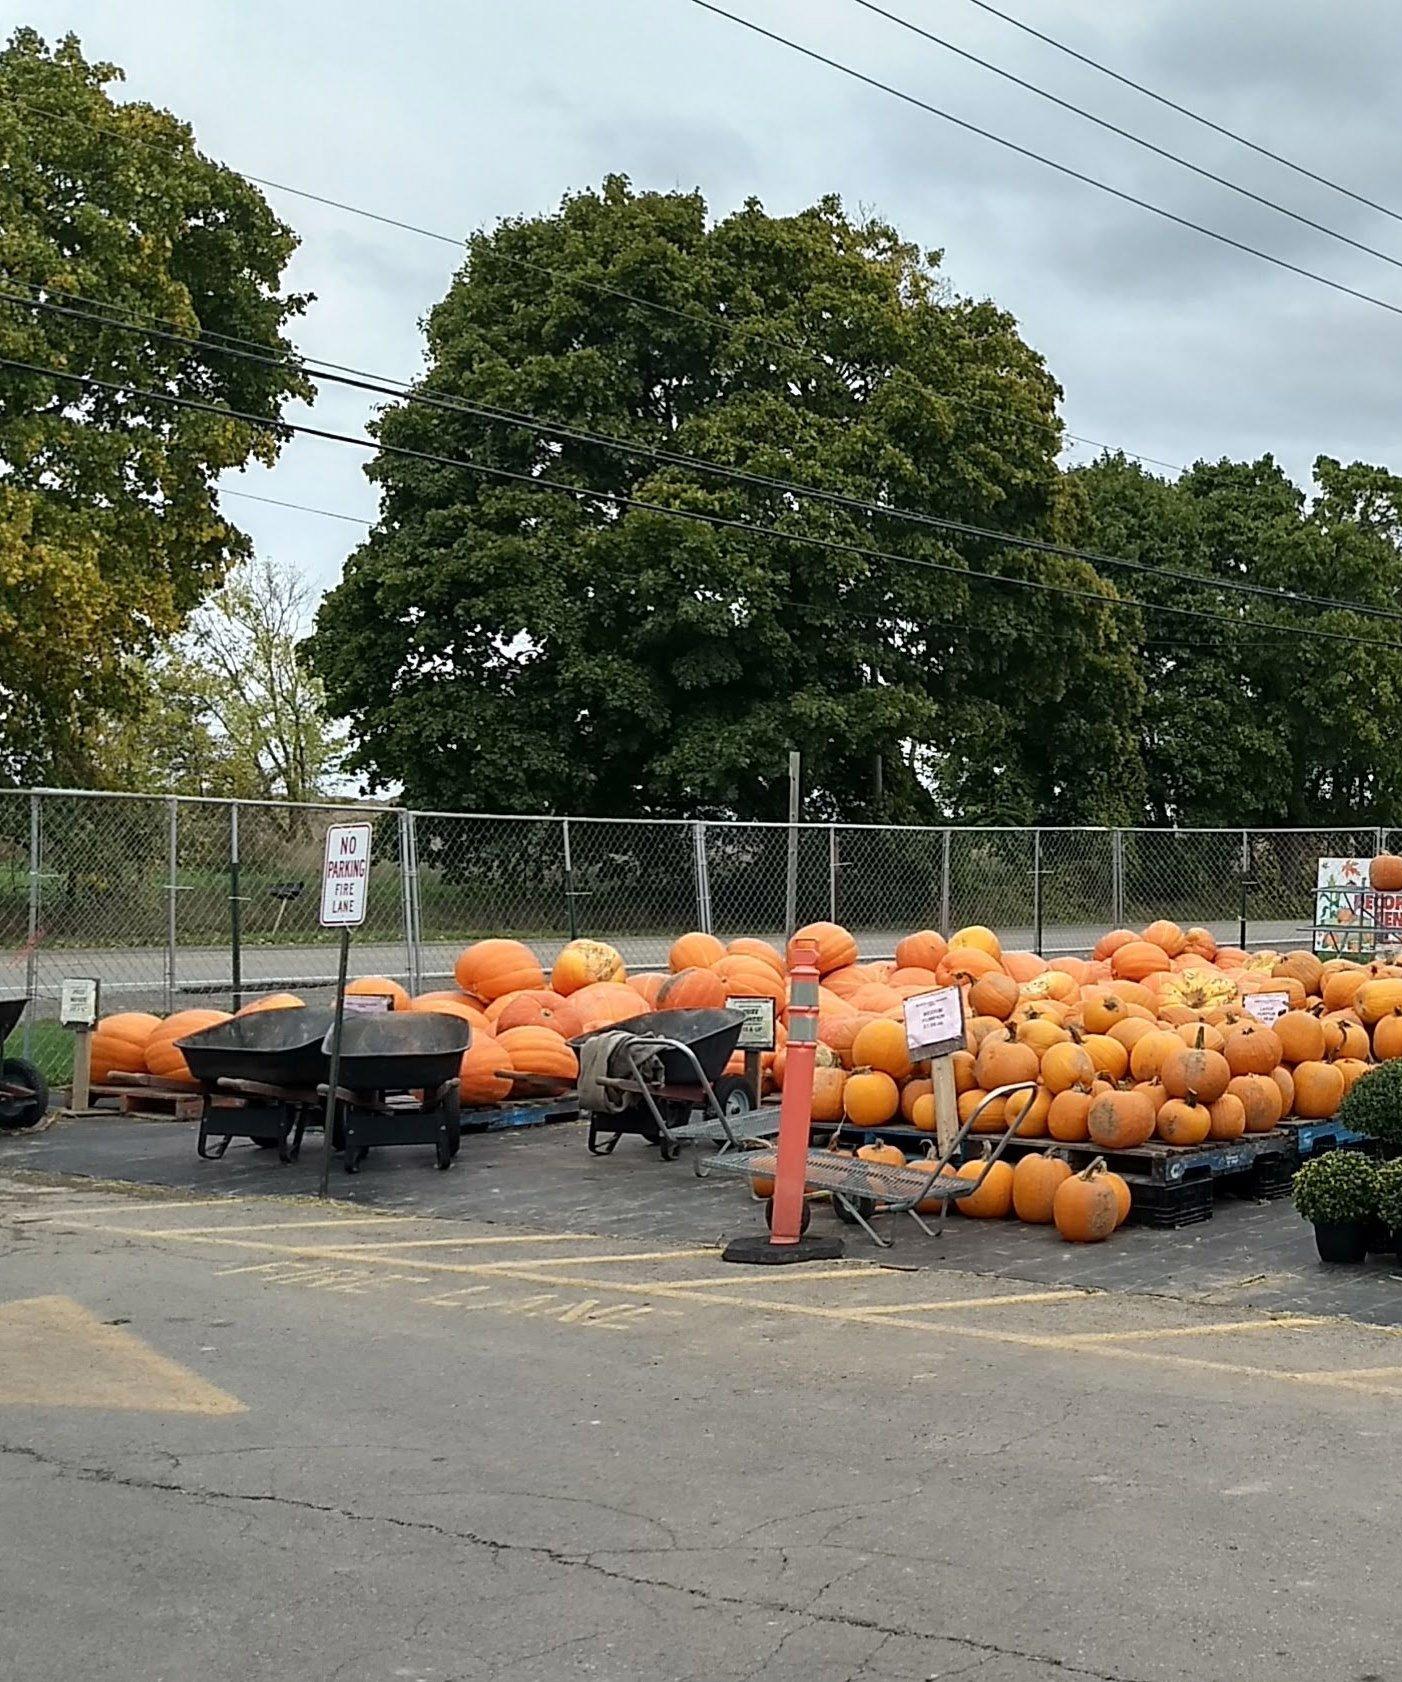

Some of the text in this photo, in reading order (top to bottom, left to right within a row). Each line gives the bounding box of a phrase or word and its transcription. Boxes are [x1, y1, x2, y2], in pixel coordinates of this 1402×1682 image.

[340, 836, 357, 855] NO
[328, 860, 365, 878] PARKING
[335, 883, 355, 896] FIRE
[332, 900, 355, 914] LANE
